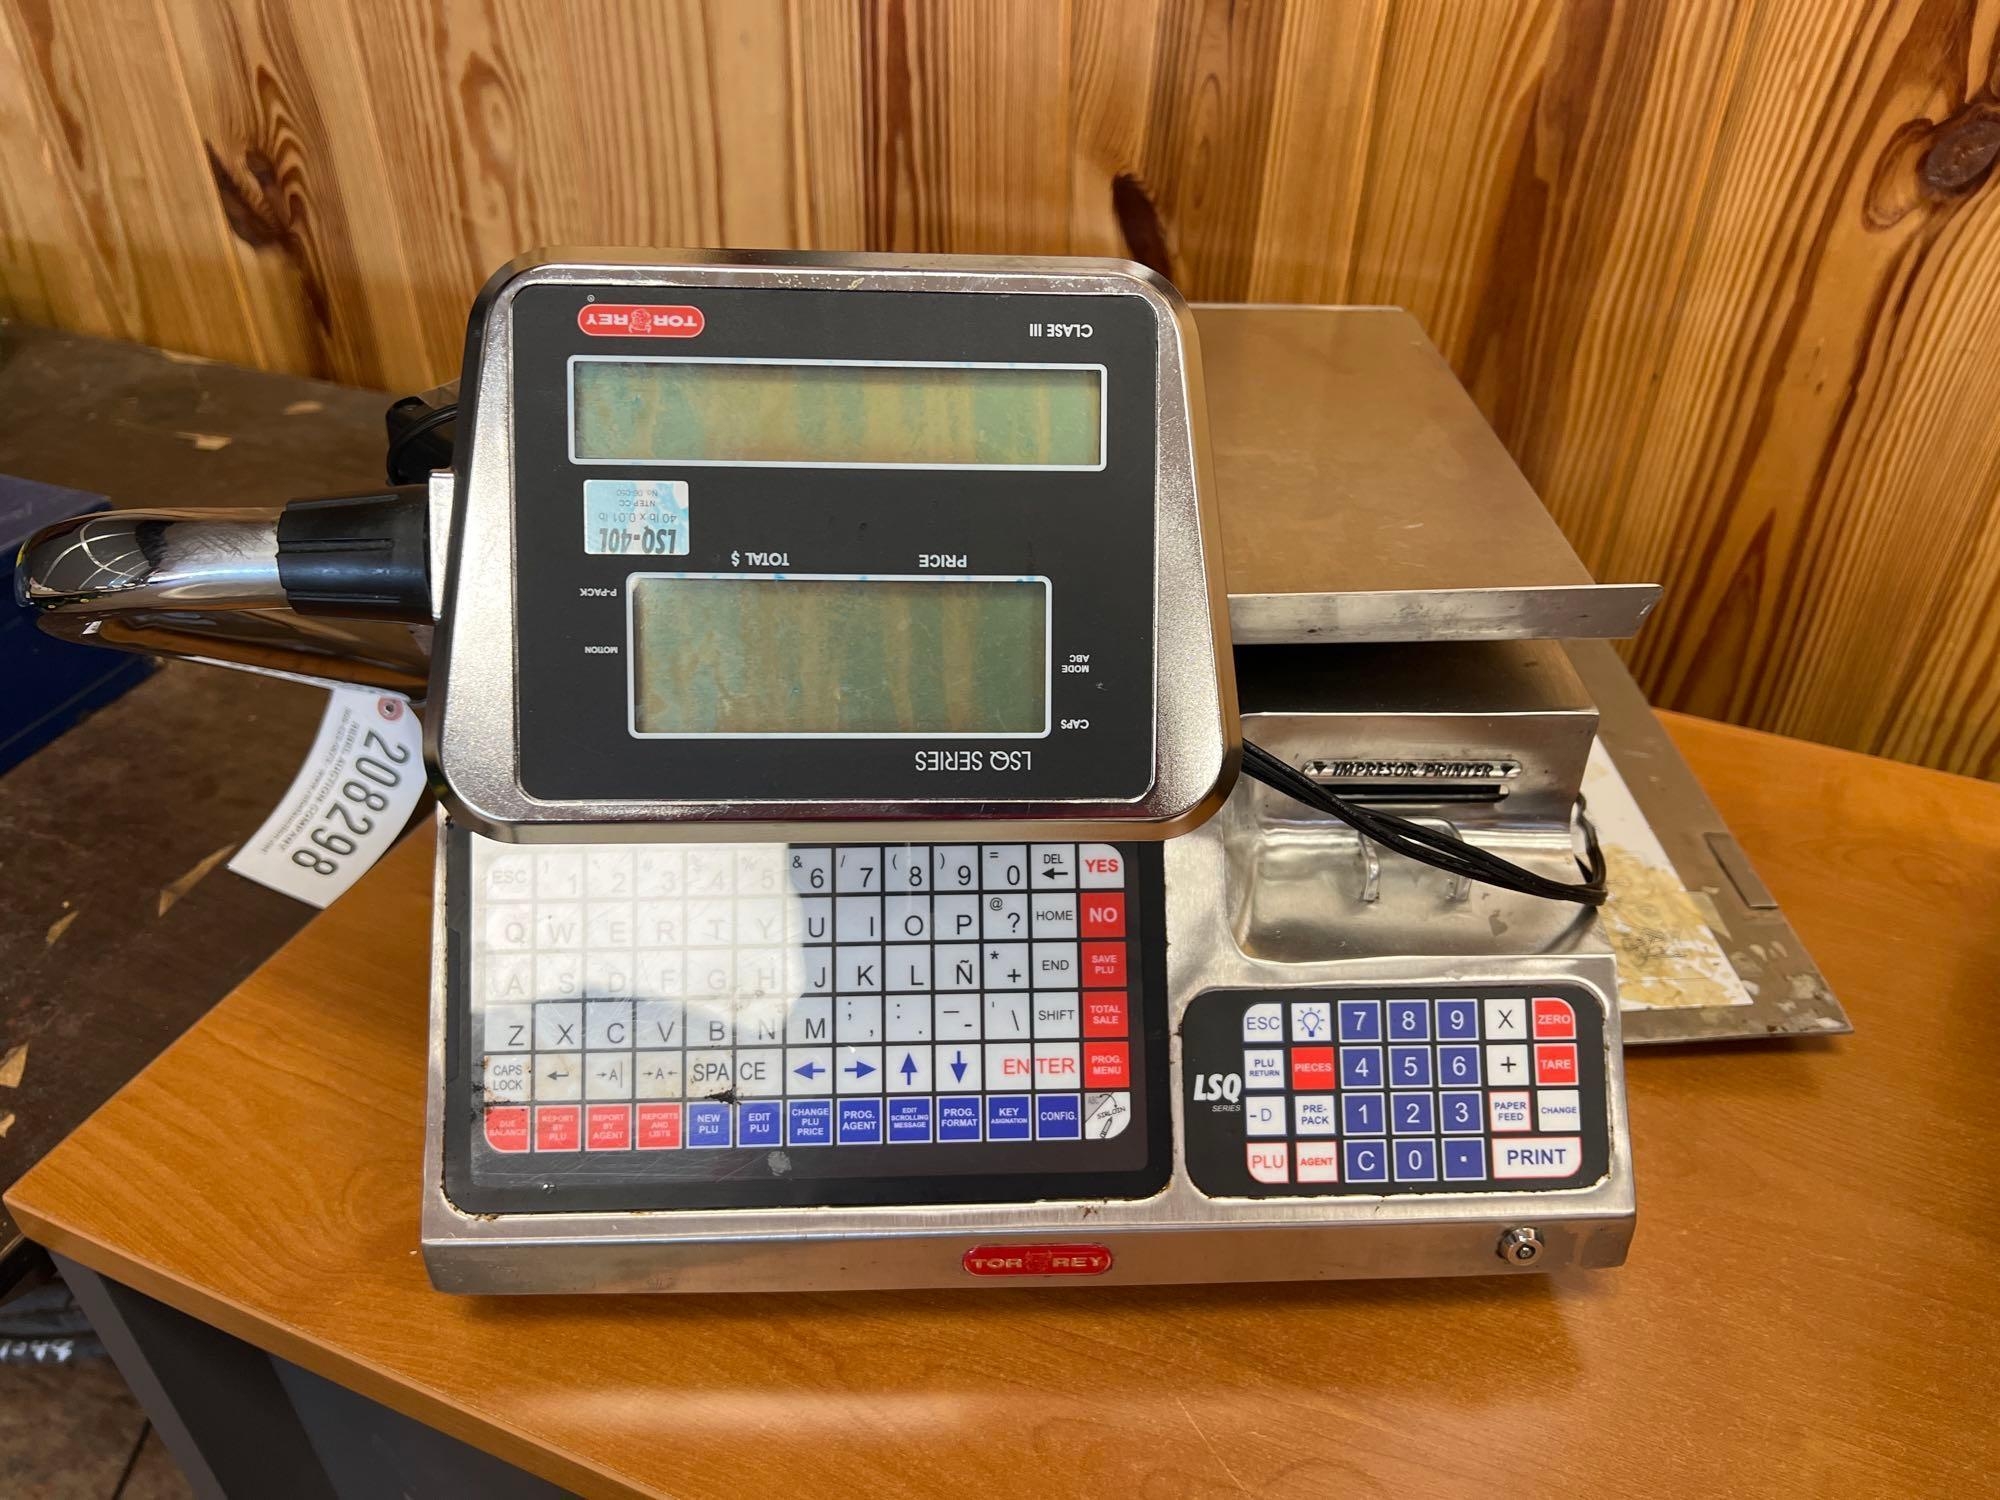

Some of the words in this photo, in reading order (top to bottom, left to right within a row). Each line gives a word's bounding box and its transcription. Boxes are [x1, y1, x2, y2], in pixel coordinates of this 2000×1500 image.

[586, 314, 628, 325] REY
[653, 315, 697, 327] TOR
[1030, 324, 1041, 336] III
[1047, 324, 1093, 337] CLASE
[650, 514, 659, 523] lb
[663, 513, 677, 523] 40
[600, 525, 676, 553] LSQ-40L
[731, 551, 740, 567] $
[745, 552, 790, 566] TOTAL
[919, 555, 967, 568] PRICE
[580, 588, 617, 596] P-PACK
[1062, 665, 1089, 673] MODE
[1061, 720, 1089, 729] CAPS
[915, 751, 983, 771] SERIES
[990, 751, 1031, 771] LSQ
[292, 730, 411, 875] 208298
[792, 855, 803, 868] &
[1044, 854, 1063, 864] DEL
[1086, 859, 1119, 873] YES
[492, 870, 526, 884] ESC
[810, 868, 824, 888] 6
[860, 868, 873, 887] 7
[909, 866, 922, 886] 8
[958, 866, 971, 886] 9
[990, 898, 1003, 911] @
[1037, 911, 1073, 920] HOME
[1089, 907, 1118, 922] NO
[808, 917, 825, 937] U
[905, 916, 923, 936] O
[957, 915, 972, 934] P
[1008, 912, 1020, 933] ?
[505, 922, 525, 944] Q
[548, 923, 576, 943] W
[611, 922, 626, 942] E
[656, 921, 674, 941] R
[1042, 961, 1069, 970] END
[1092, 954, 1117, 964] SAVE
[858, 966, 874, 986] K
[911, 965, 924, 985] L
[957, 960, 973, 984] Ñ
[1095, 965, 1114, 975] PLU
[505, 974, 524, 994] A
[558, 973, 575, 993] S
[608, 973, 626, 992] D
[815, 967, 825, 988] J
[1038, 1010, 1074, 1020] SHIFT
[1090, 1005, 1121, 1014] TOTAL
[1093, 1015, 1119, 1024] SALE
[1247, 1016, 1280, 1030] ESC
[1353, 1012, 1366, 1031] 7
[1402, 1011, 1415, 1030] 8
[1451, 1010, 1463, 1030] 9
[1499, 1010, 1513, 1029] X
[1538, 1013, 1570, 1025] ZERO
[558, 1024, 574, 1044] X
[607, 1023, 625, 1043] C
[657, 1021, 674, 1042] V
[709, 1021, 725, 1040] B
[759, 1019, 775, 1039] N
[806, 1018, 825, 1038] M
[508, 1025, 524, 1046] Z
[1092, 1055, 1122, 1065] PROG.
[1254, 1059, 1274, 1068] PLU
[1453, 1056, 1466, 1076] 6
[1540, 1059, 1571, 1070] TARE
[493, 1066, 522, 1076] CAPS
[1093, 1066, 1121, 1075] MENU
[1295, 1062, 1332, 1073] PIECES
[1356, 1058, 1369, 1077] 4
[1404, 1058, 1417, 1077] 5
[493, 1080, 522, 1090] LOCK
[1194, 1074, 1242, 1101] LSQ
[792, 1108, 829, 1116] CHANGE
[944, 1108, 975, 1116] PROG.
[999, 1107, 1019, 1116] KEY
[1303, 1105, 1327, 1114] PRE-
[1455, 1103, 1469, 1122] 3
[1494, 1101, 1526, 1111] PAPER
[1541, 1106, 1577, 1114] CHANGE
[542, 1115, 574, 1123] REPORT
[592, 1114, 624, 1122] REPORT
[641, 1112, 679, 1121] REPORTS
[697, 1114, 720, 1123] NEW
[748, 1113, 771, 1122] EDIT
[844, 1111, 875, 1119] PROG.
[1041, 1112, 1077, 1120] CONFIG.
[1361, 1105, 1367, 1124] 1
[1406, 1104, 1420, 1123] 2
[1498, 1112, 1524, 1121] FEED
[802, 1118, 819, 1126] PLU
[842, 1121, 877, 1130] AGENT
[942, 1119, 978, 1127] FORMAT
[1301, 1116, 1329, 1125] PACK
[489, 1128, 527, 1137] BALANCE
[593, 1130, 624, 1140] AGENT
[699, 1125, 718, 1134] PLU
[750, 1124, 769, 1133] PLU
[797, 1127, 824, 1136] PRICE
[1252, 1156, 1284, 1169] PLU
[1300, 1157, 1333, 1166] AGENT
[1358, 1151, 1375, 1172] C
[1409, 1151, 1421, 1170] 0
[1507, 1149, 1566, 1166] PRINT
[971, 1258, 1022, 1269] TOR
[1052, 1257, 1103, 1267] REY
